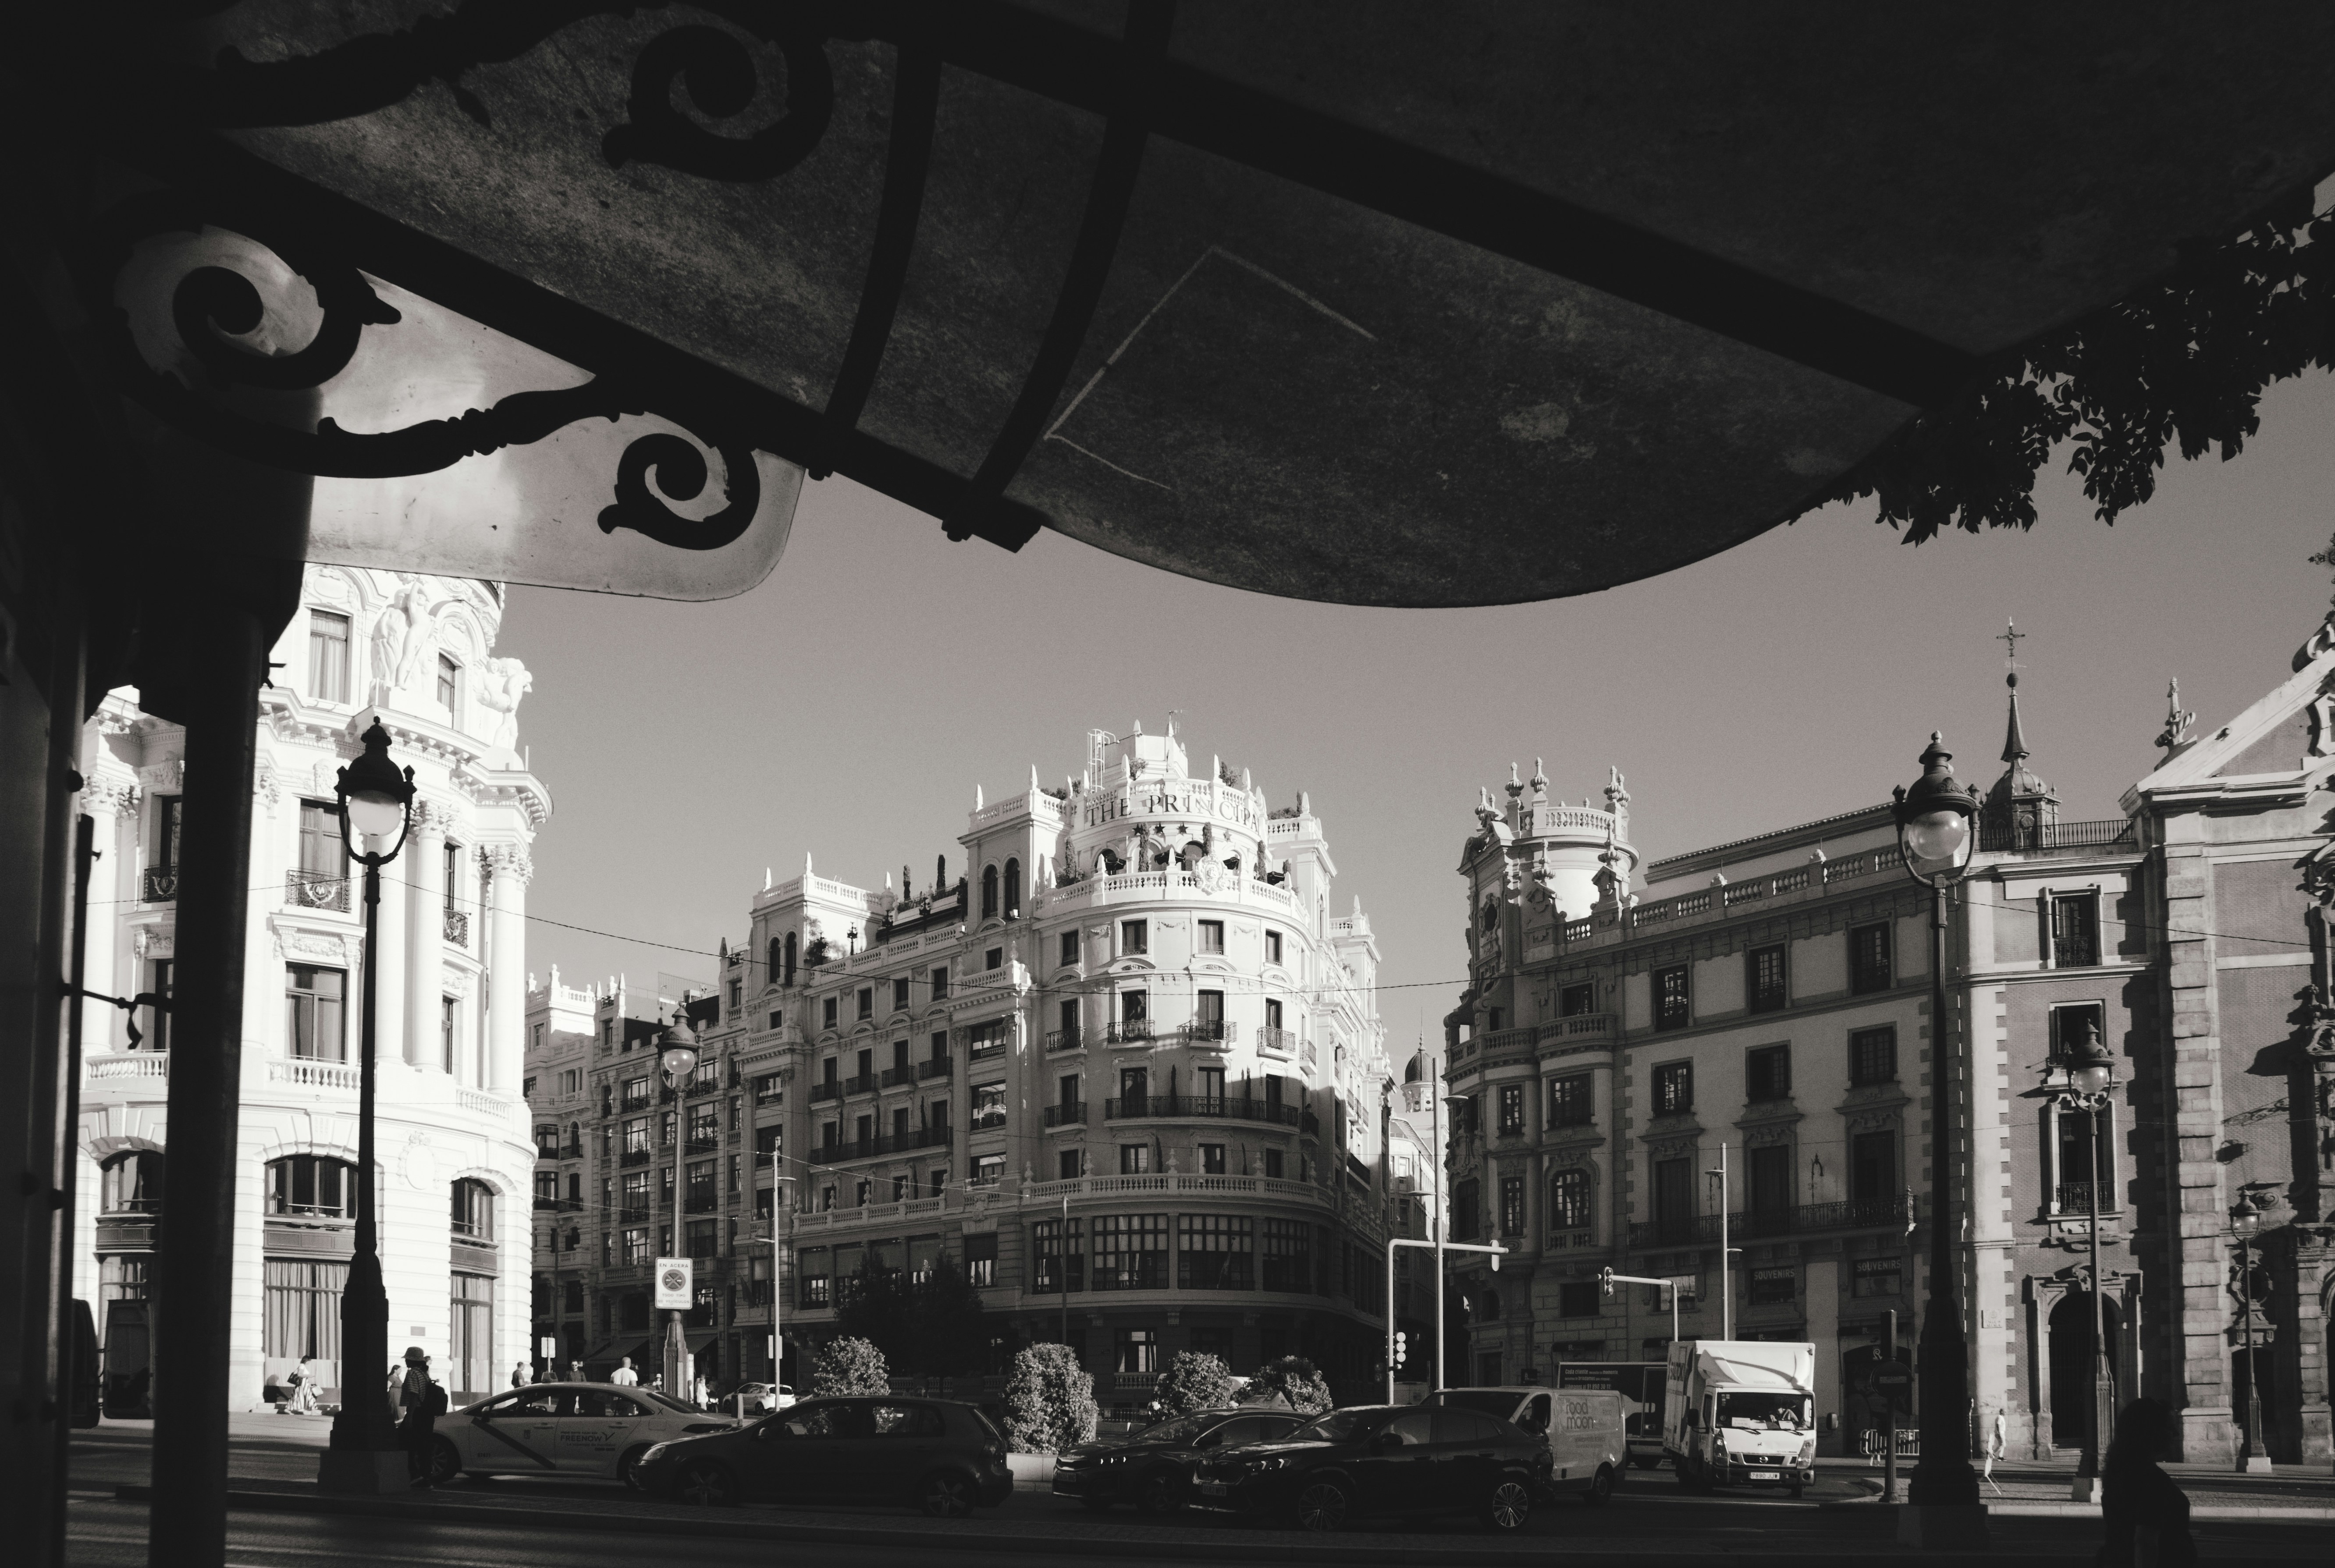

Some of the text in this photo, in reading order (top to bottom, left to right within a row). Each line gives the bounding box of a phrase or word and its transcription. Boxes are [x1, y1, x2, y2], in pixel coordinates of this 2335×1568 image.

[1087, 798, 1132, 826] THE
[1857, 1259, 1901, 1272] SOUVENIRS
[1754, 1268, 1795, 1280] SOUVENIRS
[1567, 1416, 1594, 1429] moon
